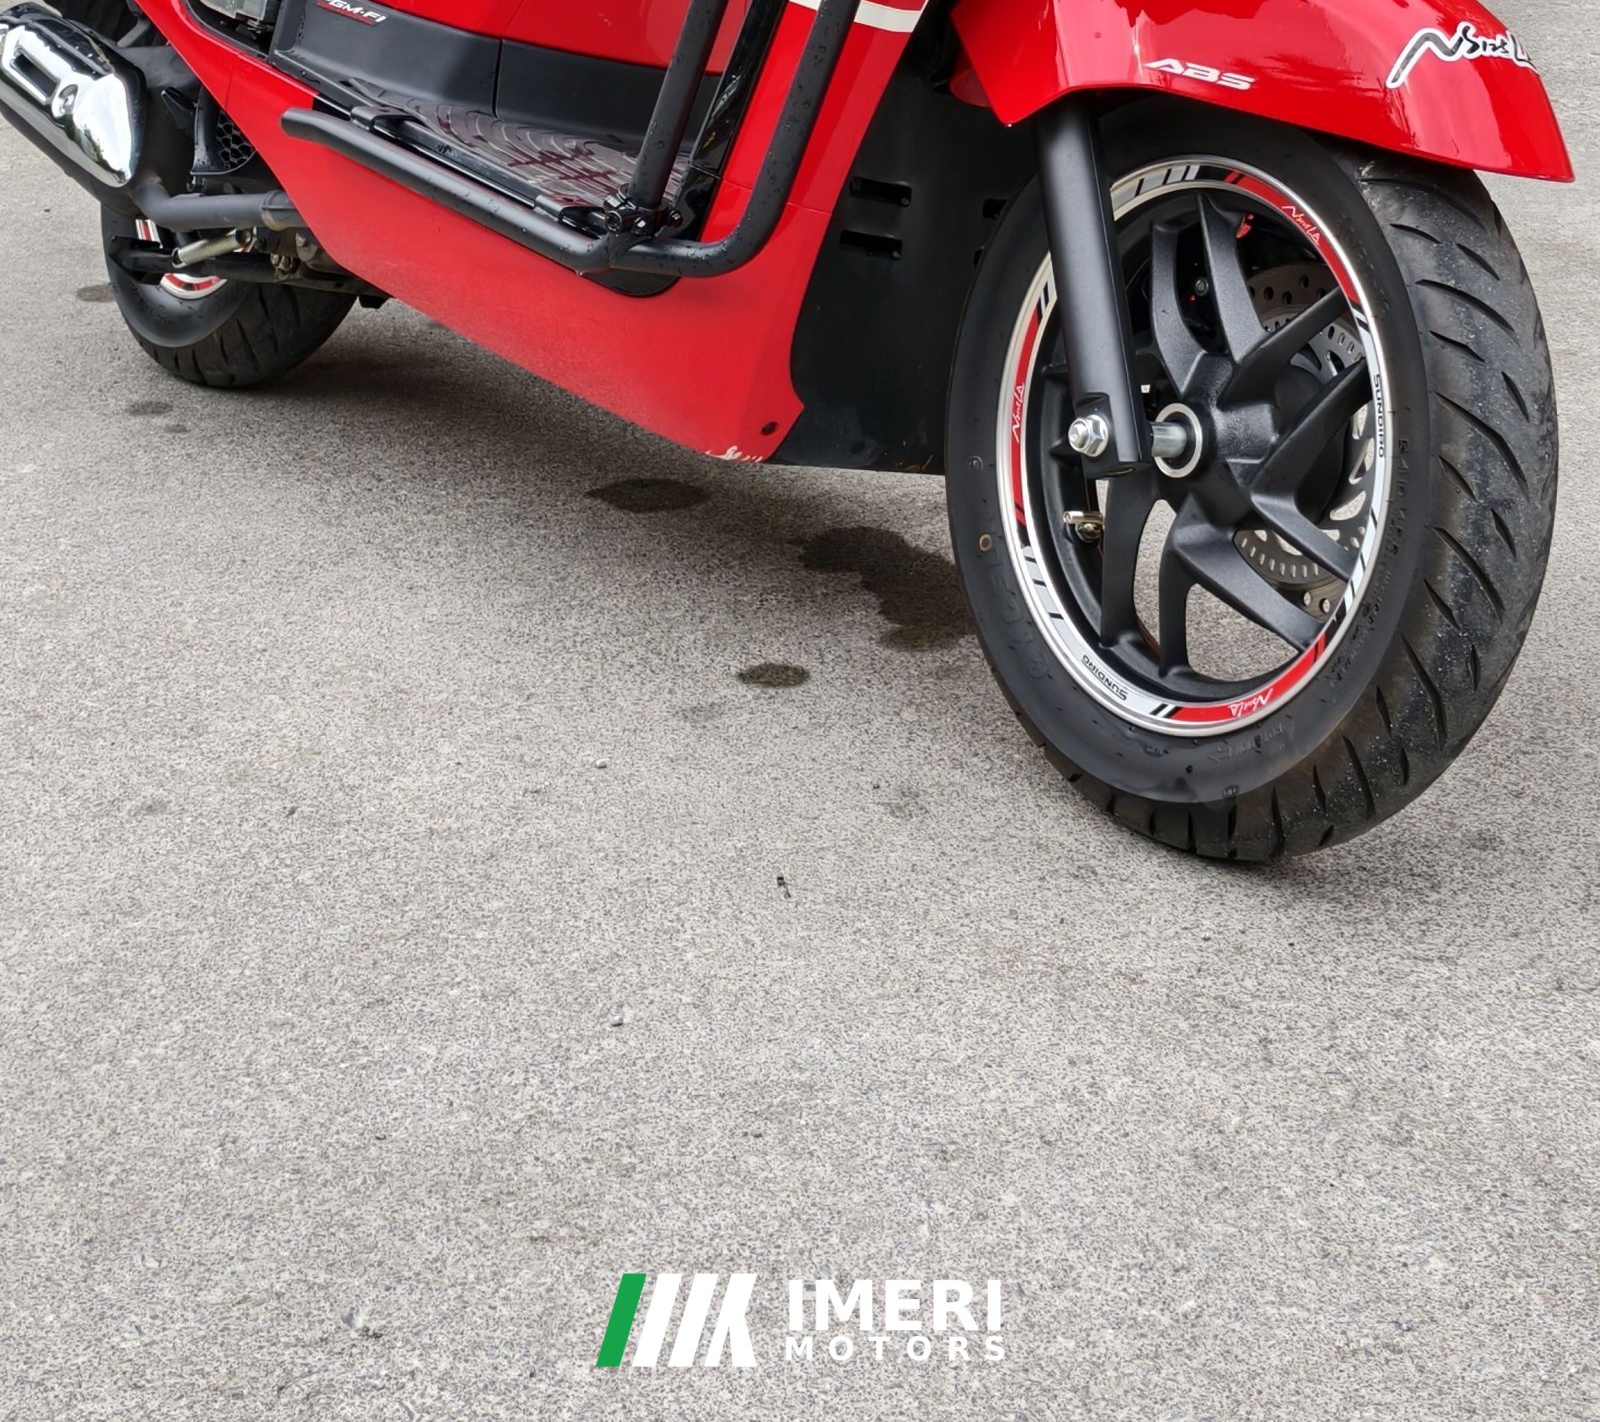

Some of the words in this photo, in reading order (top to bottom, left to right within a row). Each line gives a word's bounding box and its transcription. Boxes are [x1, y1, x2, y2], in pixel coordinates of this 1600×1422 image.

[1143, 57, 1256, 90] ABS
[1373, 374, 1385, 458] SUNDIRO
[1081, 653, 1129, 702] SUNDIRO
